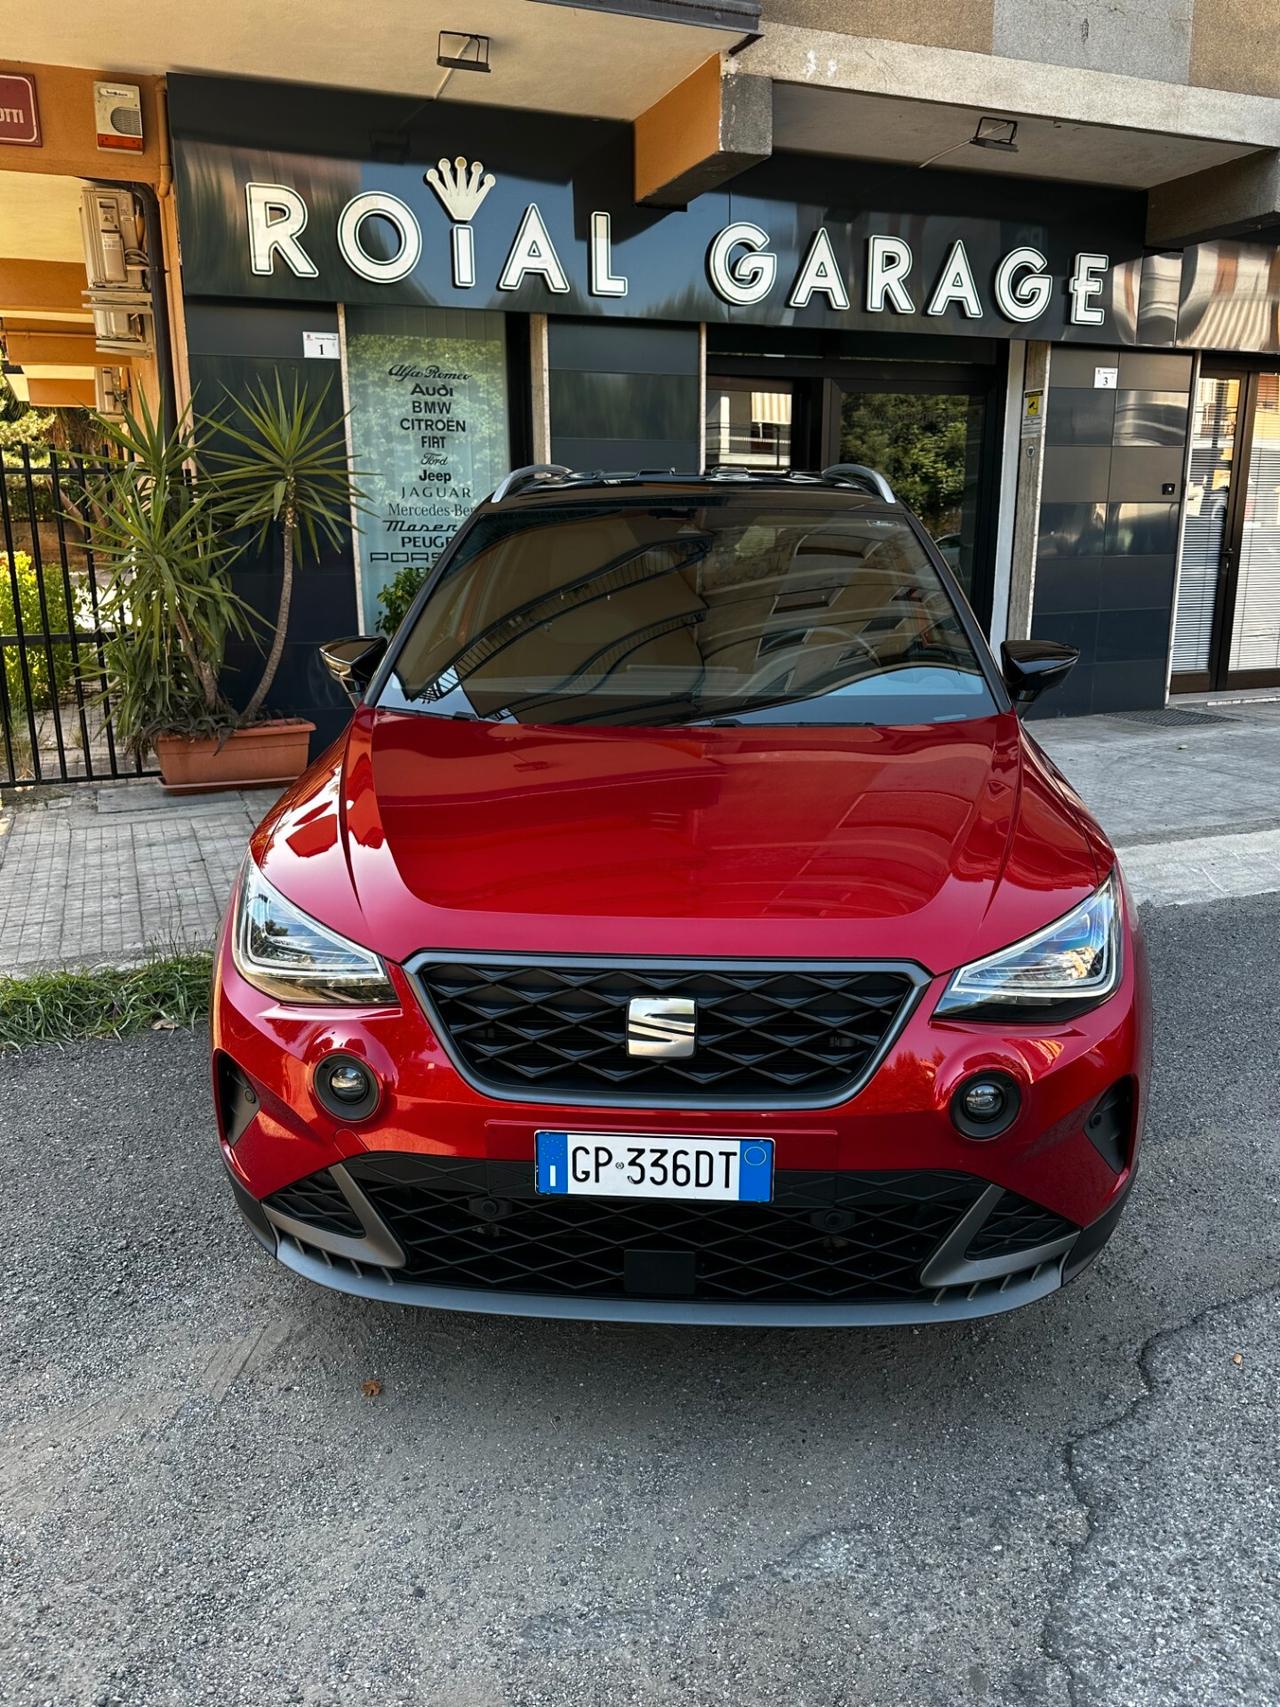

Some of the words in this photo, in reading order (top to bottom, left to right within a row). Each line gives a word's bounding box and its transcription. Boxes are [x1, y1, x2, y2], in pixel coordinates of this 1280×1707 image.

[246, 156, 629, 296] ROYAL
[708, 222, 1109, 325] GARAGE
[319, 343, 325, 355] 1
[388, 364, 423, 382] Alfa
[424, 364, 472, 380] Romeo
[1102, 376, 1109, 386] 3
[410, 383, 454, 397] Audi
[412, 400, 452, 414] BMW
[400, 417, 466, 432] CITROËN
[421, 435, 446, 448] FIAT
[420, 452, 448, 466] Ford
[419, 469, 451, 484] Jeep
[401, 486, 471, 499] JAGUAR
